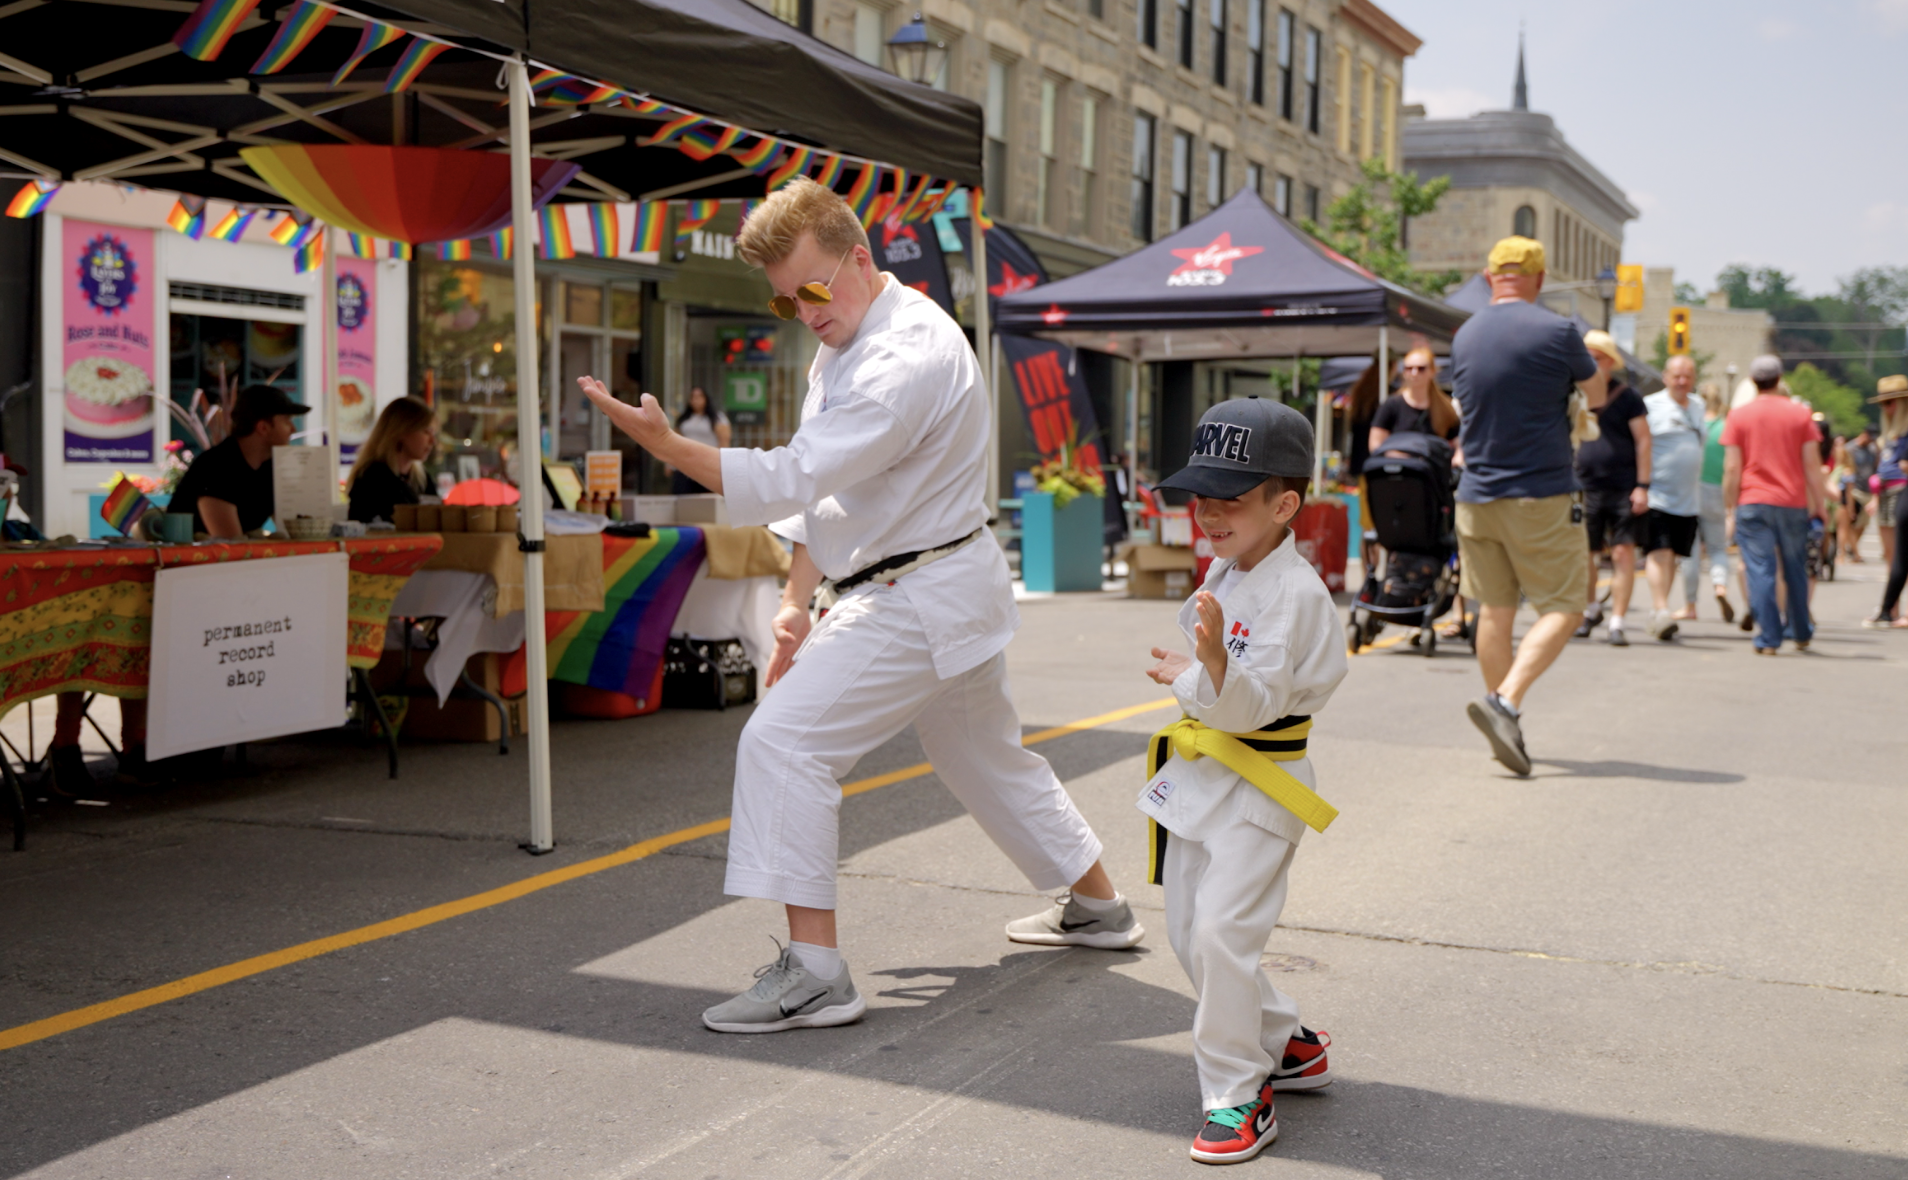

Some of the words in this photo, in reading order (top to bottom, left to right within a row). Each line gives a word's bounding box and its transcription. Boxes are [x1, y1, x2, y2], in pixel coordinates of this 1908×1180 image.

[67, 325, 94, 343] Rose
[98, 324, 119, 338] and
[729, 378, 763, 403] TD
[1190, 422, 1252, 464] ARVEL
[203, 616, 291, 647] permanent
[219, 640, 275, 665] record
[227, 669, 266, 687] shop
